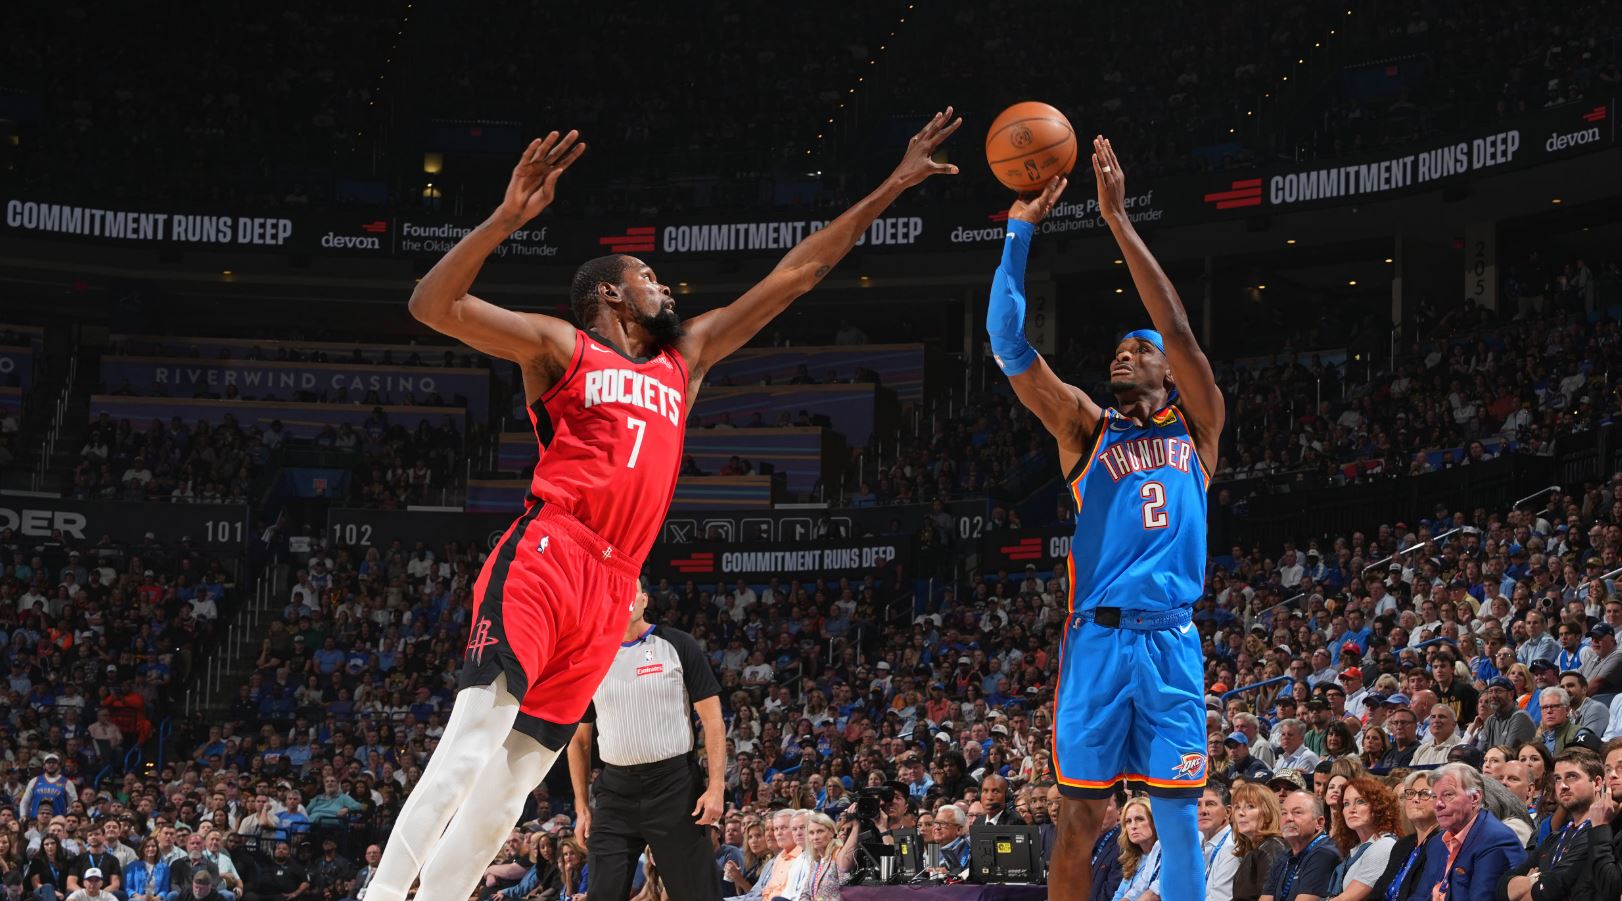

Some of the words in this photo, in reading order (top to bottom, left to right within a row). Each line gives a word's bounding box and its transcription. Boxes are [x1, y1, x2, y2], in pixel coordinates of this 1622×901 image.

[1545, 126, 1600, 153] devon
[1270, 154, 1415, 205] COMMITMENT
[1418, 141, 1468, 184] RUNS
[1472, 129, 1520, 168] DEEP
[1139, 190, 1153, 206] of
[6, 199, 168, 240] COMMITMENT
[172, 214, 232, 244] RUNS
[237, 216, 292, 245] DEEP
[532, 227, 548, 241] of
[663, 220, 801, 253] COMMITMENT
[871, 216, 923, 245] DEEP
[950, 225, 1004, 242] devon
[1042, 218, 1094, 234] Oklahoma
[321, 232, 380, 249] devon
[403, 239, 421, 251] the
[509, 244, 557, 257] Thunder
[1474, 241, 1485, 296] 205
[155, 366, 317, 389] RIVERWIND
[331, 374, 437, 393] CASINO
[585, 368, 681, 427] ROCKETS
[626, 417, 647, 469] 7
[1098, 437, 1193, 483] THUNDER
[1140, 481, 1169, 530] 2
[206, 520, 242, 543] 101
[333, 523, 372, 546] 102
[721, 549, 822, 573] COMMITMENT
[823, 548, 859, 570] RUNS
